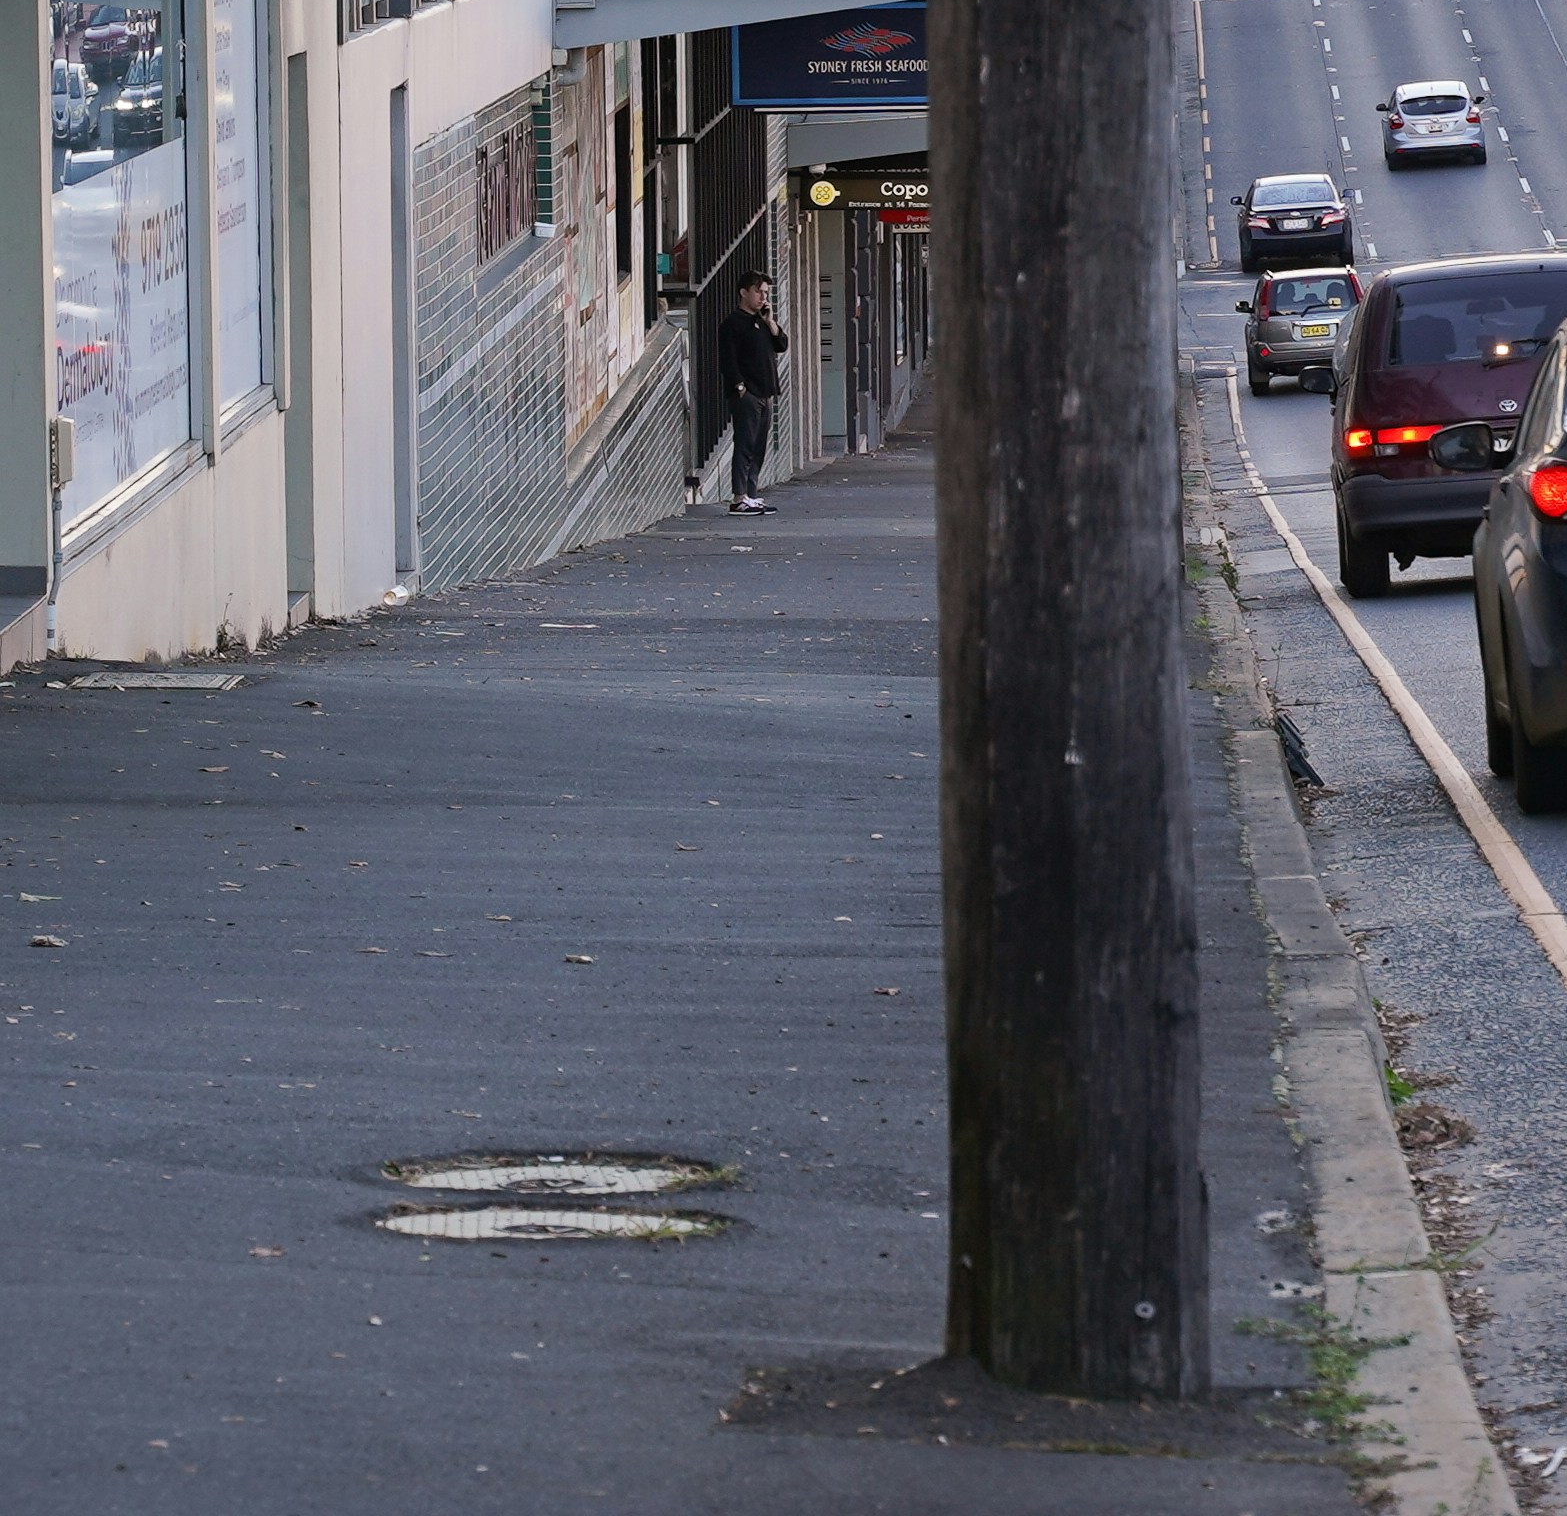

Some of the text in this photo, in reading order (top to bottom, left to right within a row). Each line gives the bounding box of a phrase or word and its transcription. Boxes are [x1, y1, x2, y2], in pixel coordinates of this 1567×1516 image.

[808, 59, 929, 74] SYDNEY FRESH SEAFOOD
[880, 182, 929, 200] Copo
